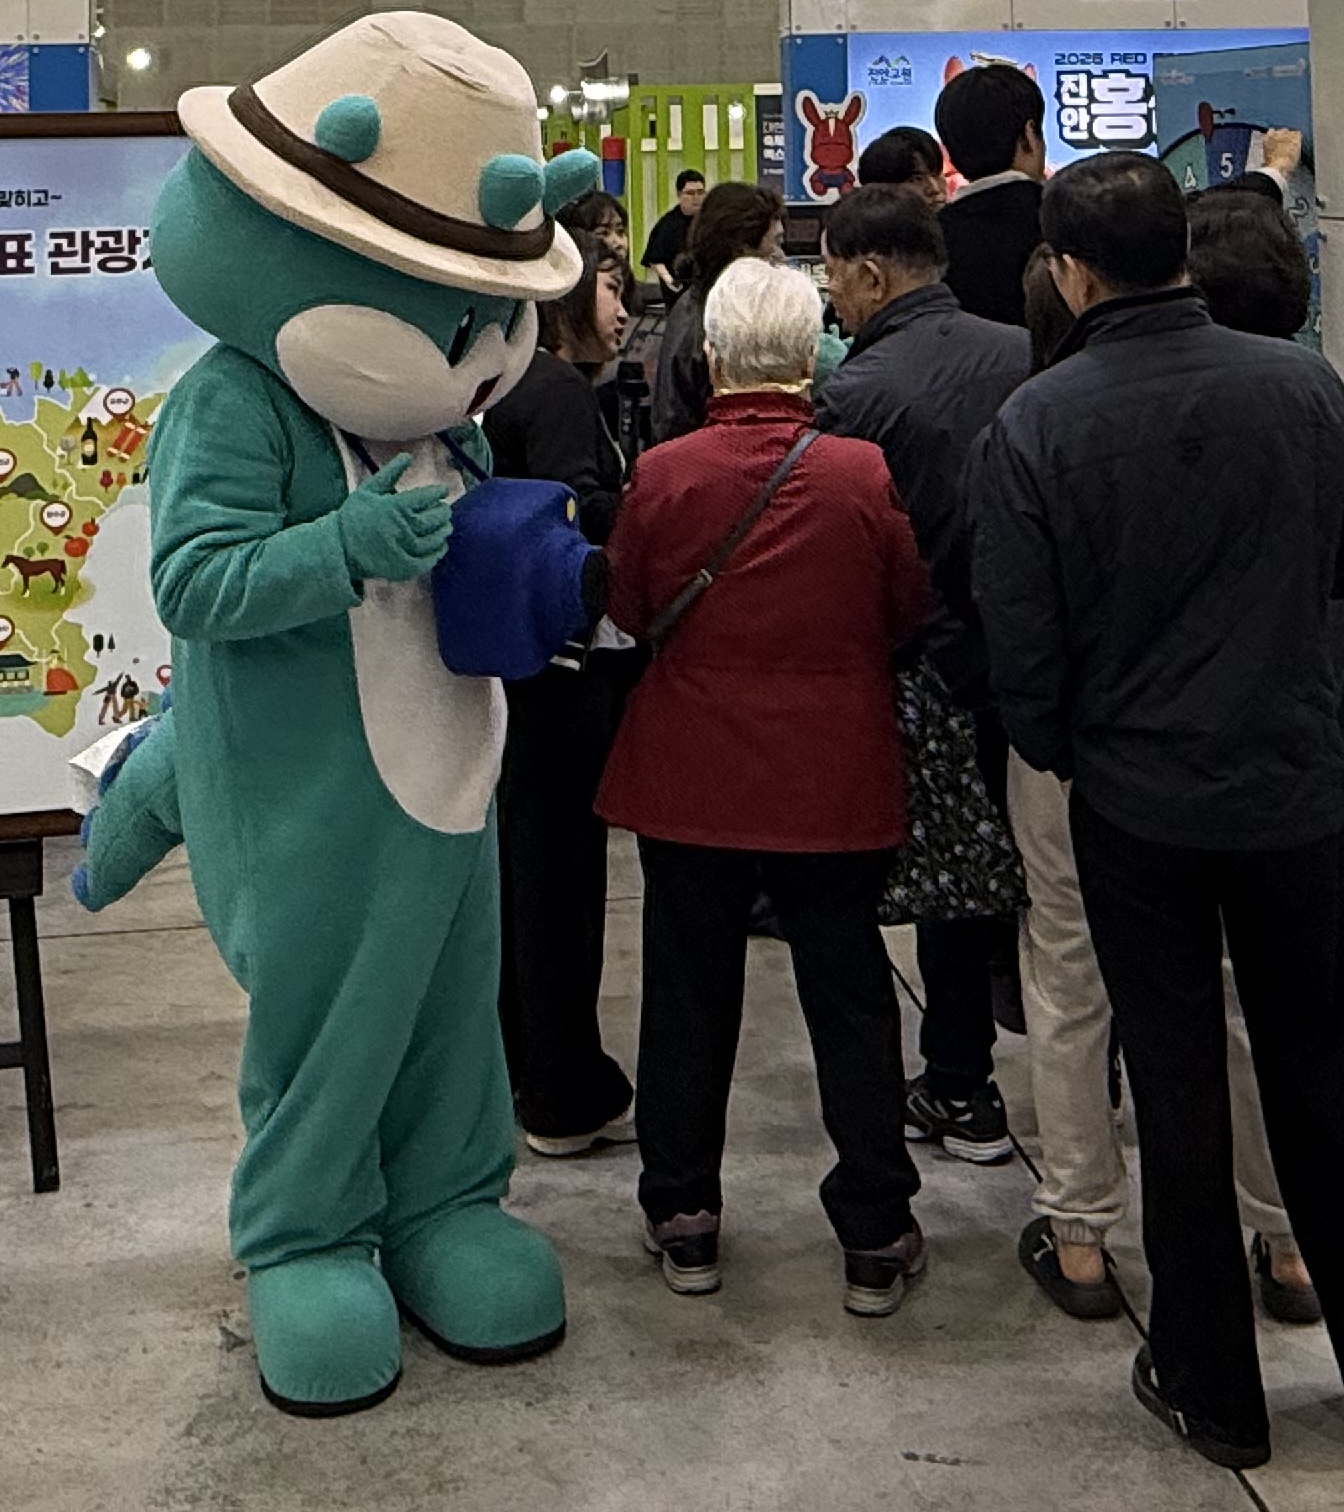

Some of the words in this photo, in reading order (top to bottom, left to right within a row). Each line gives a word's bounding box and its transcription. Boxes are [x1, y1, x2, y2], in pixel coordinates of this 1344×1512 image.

[1111, 53, 1147, 65] RED
[1091, 73, 1156, 140] 홍
[1220, 152, 1234, 178] 5
[47, 229, 155, 276] 관광
